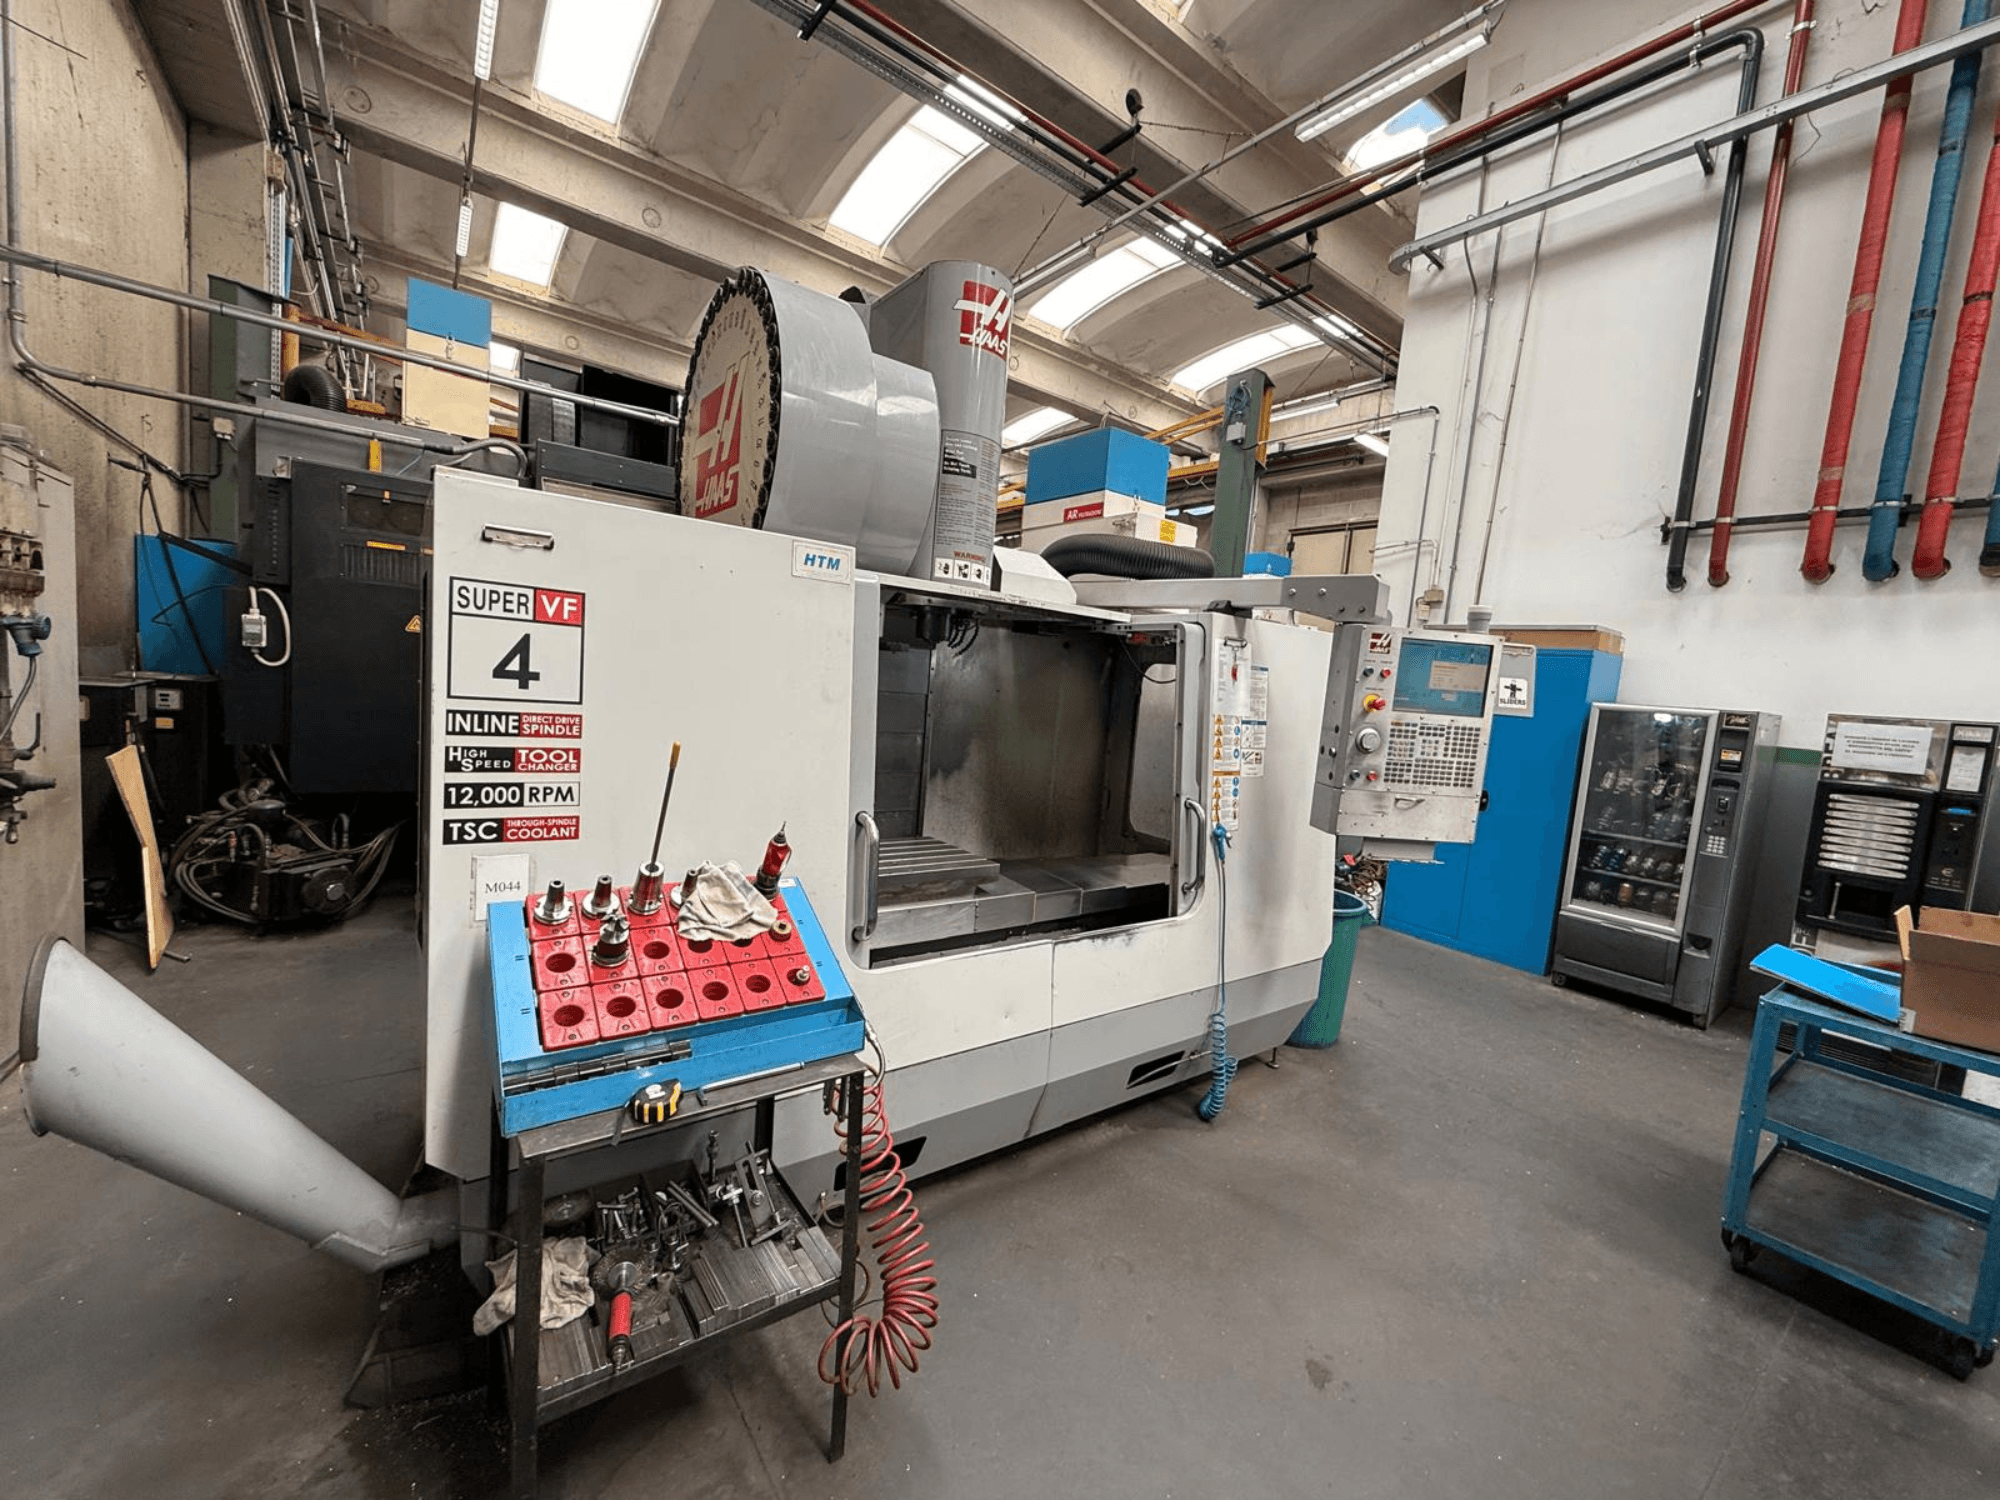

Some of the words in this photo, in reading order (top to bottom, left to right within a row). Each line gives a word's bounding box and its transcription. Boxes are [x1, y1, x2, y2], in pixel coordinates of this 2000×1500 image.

[960, 328, 1008, 355] HAAS
[695, 464, 740, 512] HAAS
[804, 553, 841, 571] HTM
[457, 586, 529, 615] SUPER
[541, 594, 578, 620] VF
[492, 633, 540, 690] 4
[447, 712, 519, 734] INLINE
[521, 715, 552, 724] DIRECT
[555, 716, 580, 725] DRIVE
[522, 723, 581, 736] SPINDLE
[449, 747, 488, 761] HIGH
[518, 749, 577, 763] TOOL
[461, 758, 511, 772] SPEED
[518, 762, 577, 771] CHANGER
[448, 786, 520, 806] 12,000
[529, 786, 575, 803] RPM
[507, 818, 577, 827] THROUGH-SPINDLE
[449, 821, 498, 841] TSC
[506, 827, 577, 840] COOLANT
[485, 880, 521, 894] M044
